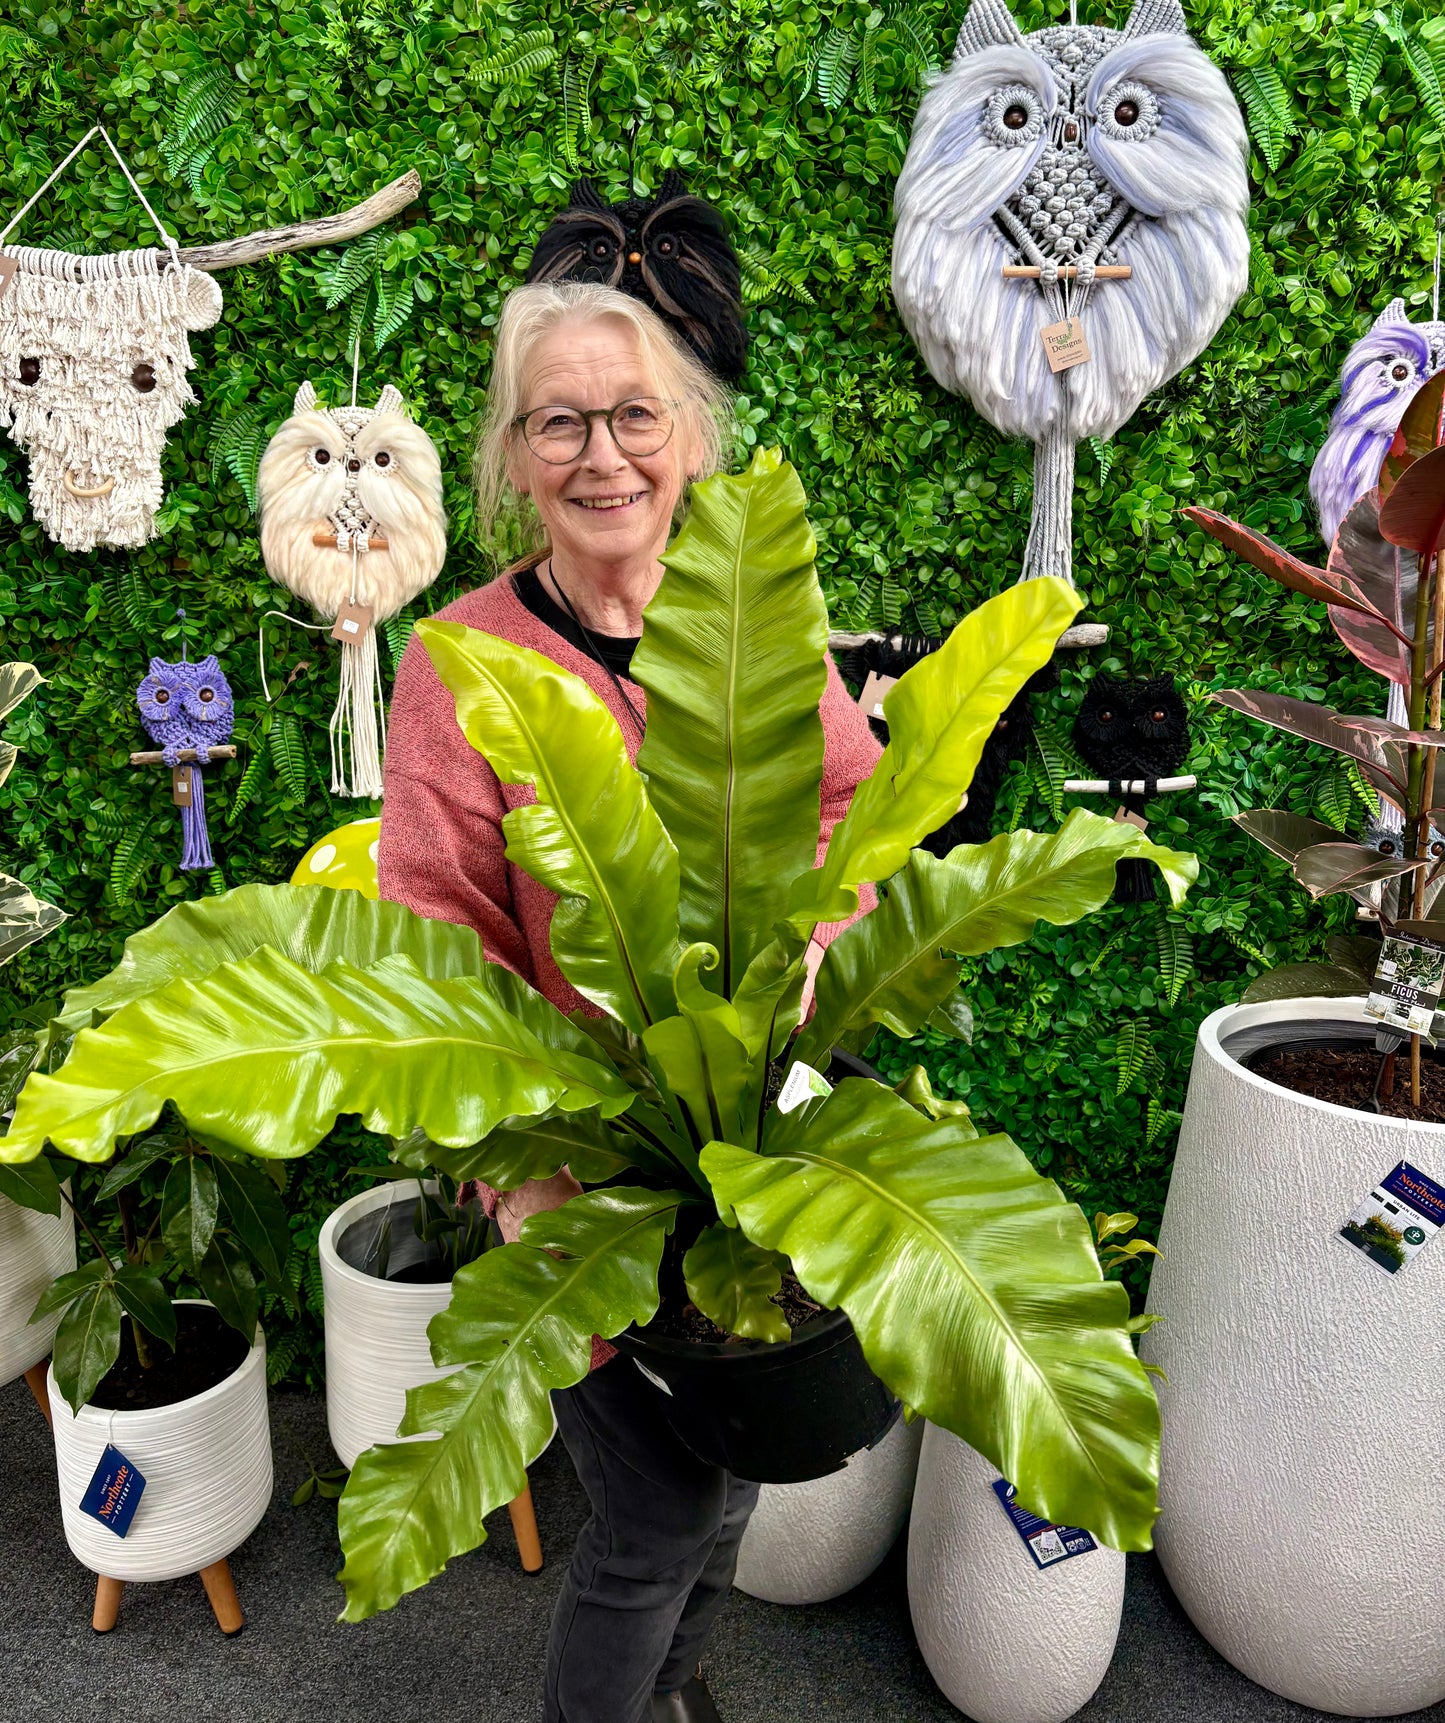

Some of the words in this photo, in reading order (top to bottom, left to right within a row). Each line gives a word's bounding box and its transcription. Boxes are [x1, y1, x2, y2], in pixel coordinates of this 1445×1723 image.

[1045, 333, 1068, 344] Terra
[1051, 339, 1083, 353] Designs
[1421, 937, 1442, 950] Design
[1390, 984, 1419, 1000] FICUS
[783, 1069, 801, 1104] ASPLENIUM
[1398, 1172, 1445, 1210] Northcote
[1403, 1186, 1434, 1208] POTTERY
[1392, 1199, 1409, 1213] URBAN
[1409, 1211, 1421, 1221] LITE
[98, 1465, 129, 1520] Northcote
[114, 1482, 131, 1515] POTTERY
